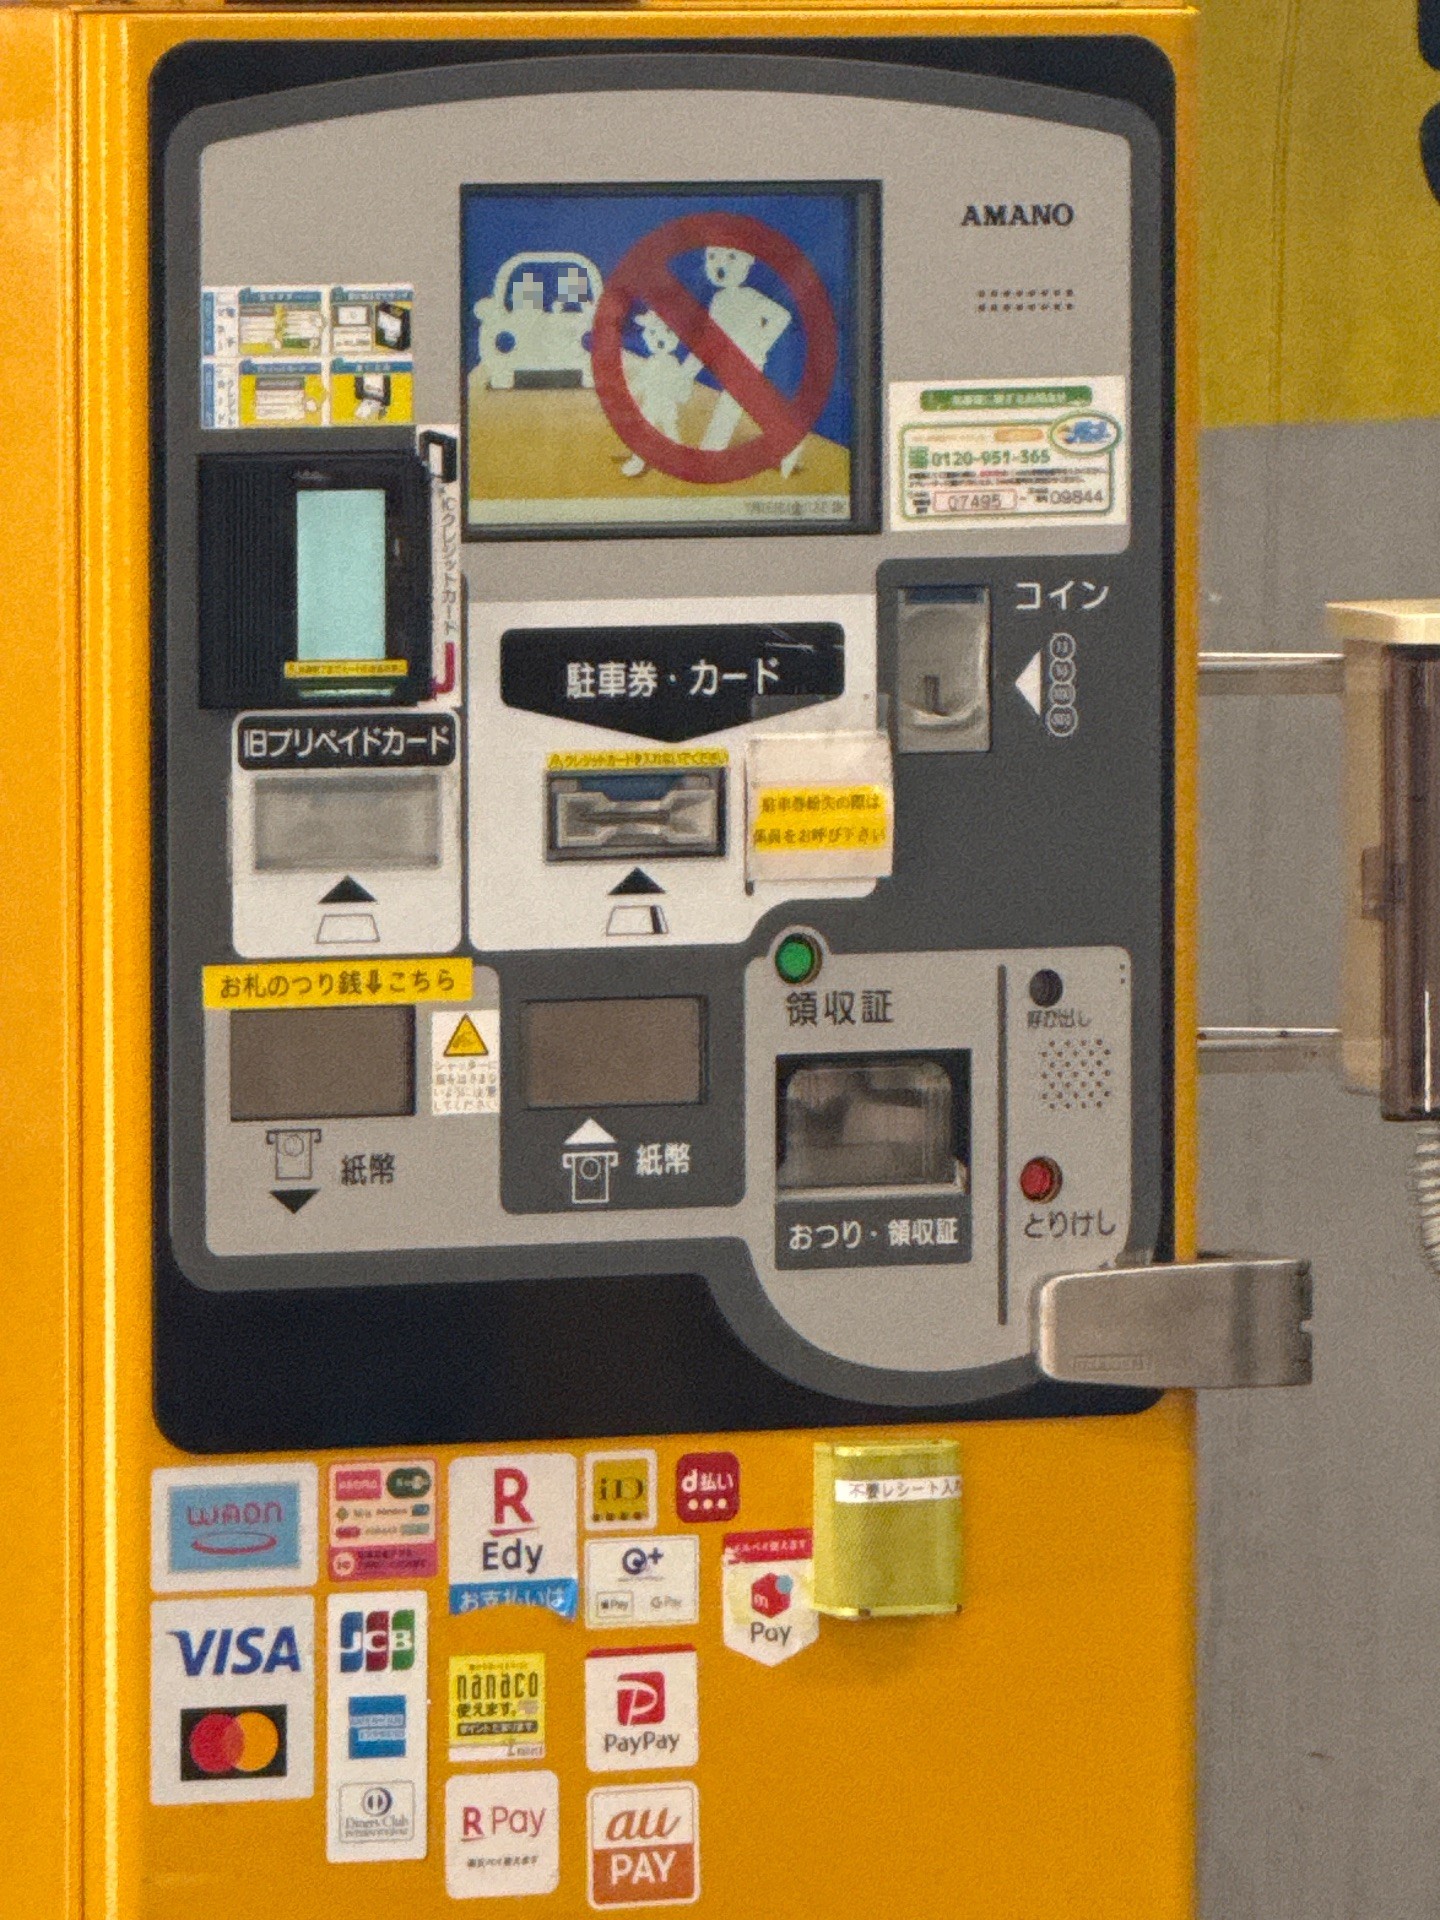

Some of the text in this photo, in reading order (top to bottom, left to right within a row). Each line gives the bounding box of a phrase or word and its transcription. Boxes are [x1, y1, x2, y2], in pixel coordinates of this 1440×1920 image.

[961, 203, 1074, 226] AMANO
[1016, 580, 1109, 611] コイン
[567, 657, 781, 699] 駐車券・カード
[243, 726, 450, 758] 旧プリペイドカード
[785, 990, 894, 1027] 領収証
[341, 1153, 396, 1186] 紙幣
[636, 1142, 691, 1175] 紙幣
[788, 1216, 959, 1250] おつり・領収証
[1023, 1211, 1117, 1240] とりけし
[494, 1467, 534, 1524] R
[600, 1477, 644, 1500] iD
[482, 1538, 544, 1575] Edy
[750, 1621, 792, 1646] Pay
[165, 1625, 302, 1677] VISA
[457, 1671, 538, 1700] nanaco
[604, 1731, 680, 1755] PayPay
[463, 1805, 546, 1838] R Pay
[605, 1807, 682, 1840] au
[610, 1851, 678, 1885] PAY
